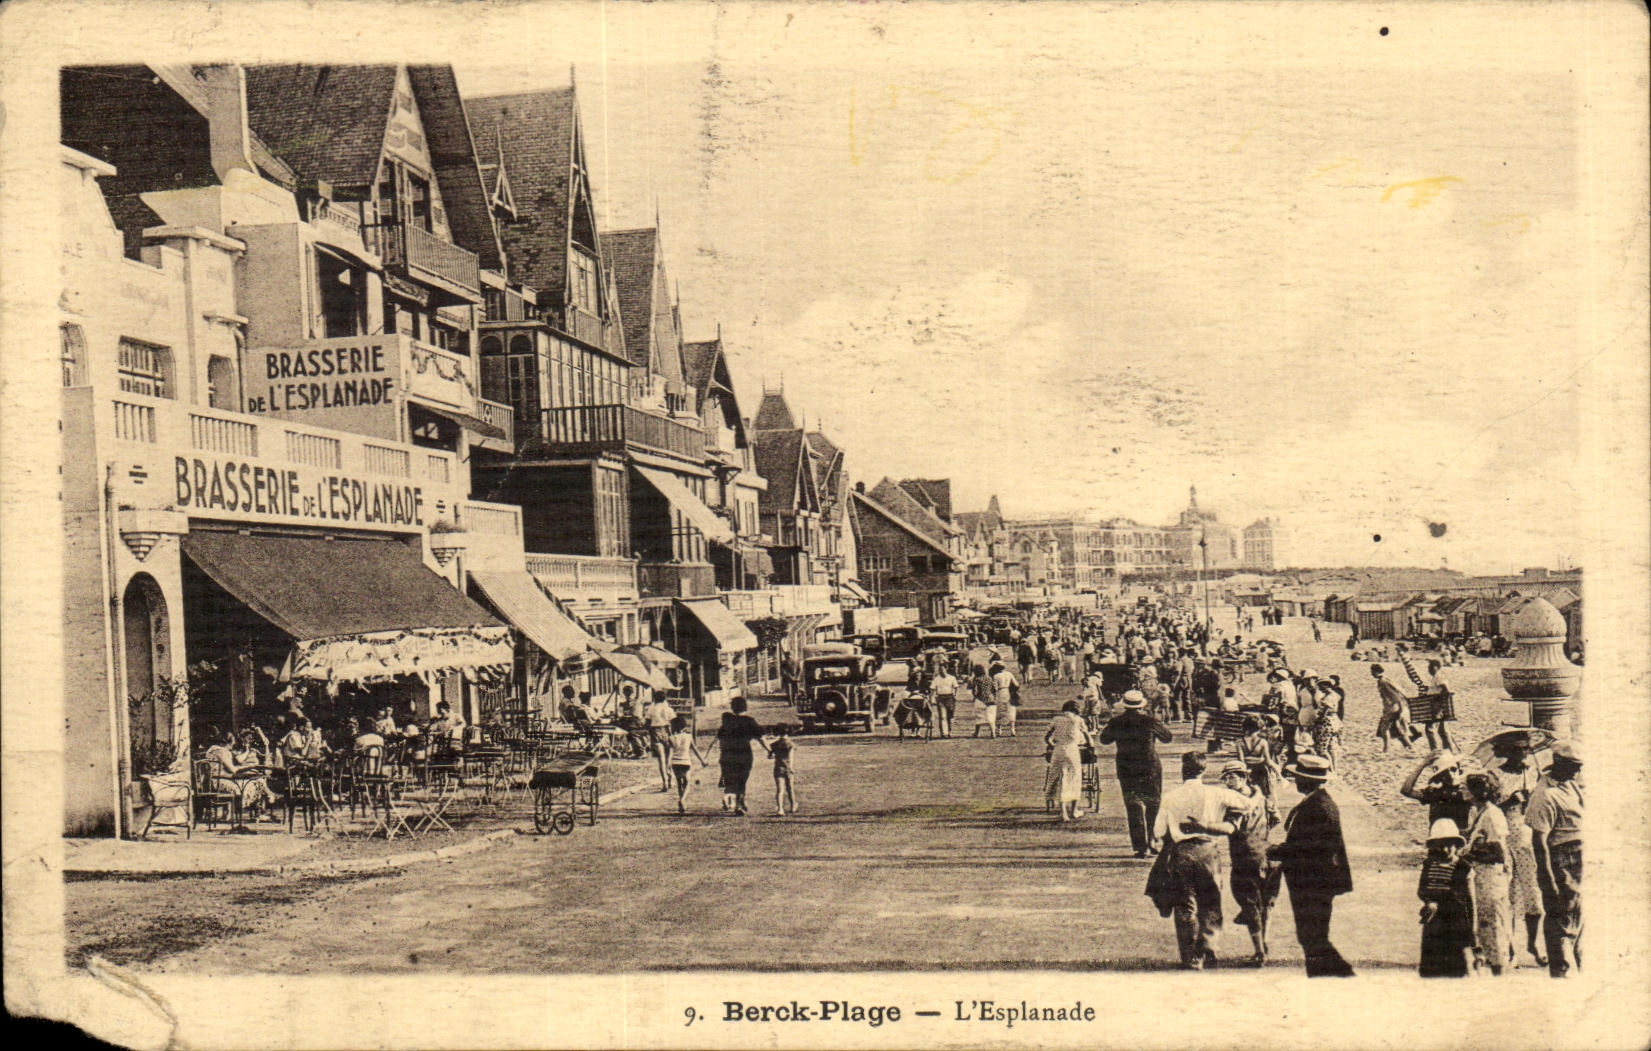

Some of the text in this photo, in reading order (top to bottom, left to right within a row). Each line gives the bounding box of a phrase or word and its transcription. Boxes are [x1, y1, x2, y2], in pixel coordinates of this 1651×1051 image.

[266, 345, 385, 379] BRASSERIE
[249, 377, 394, 413] DE L'ESPLANADE
[175, 456, 424, 526] BRASSERIE DE L'ESPLANADE
